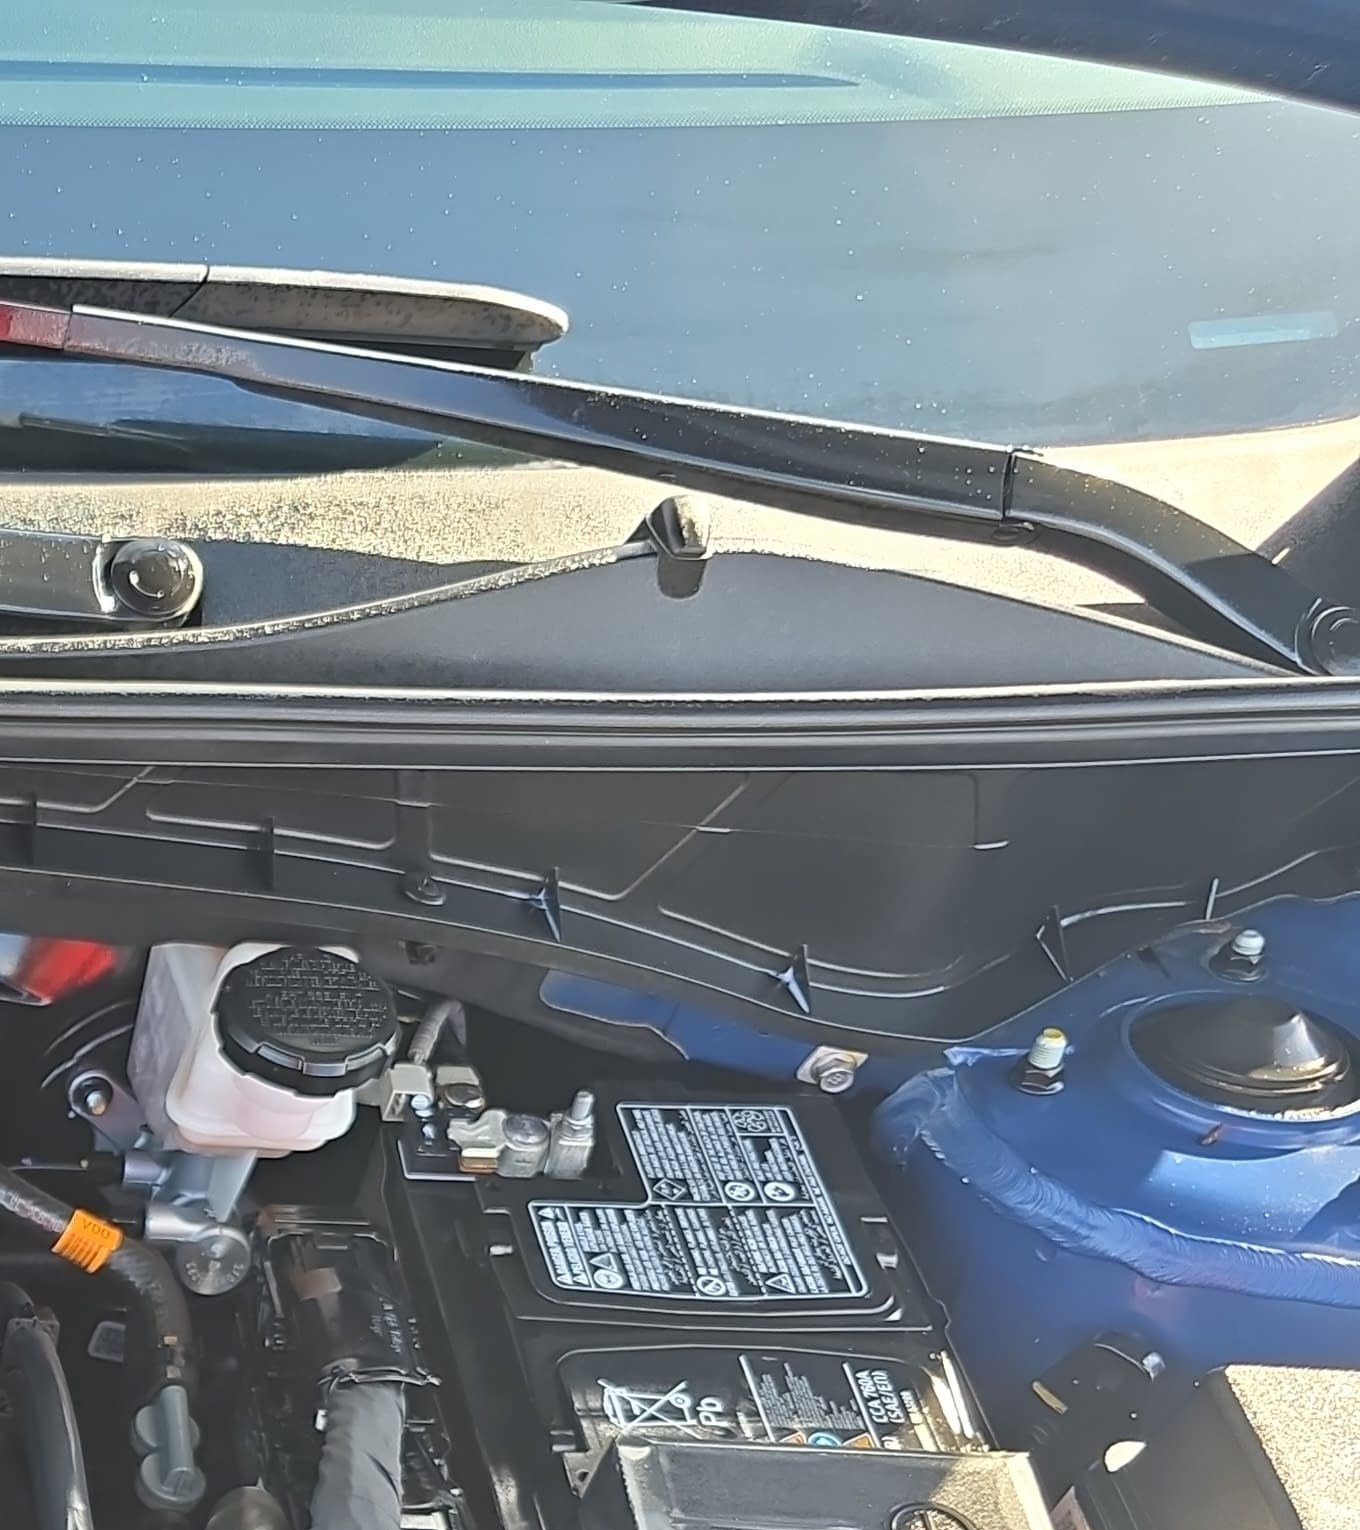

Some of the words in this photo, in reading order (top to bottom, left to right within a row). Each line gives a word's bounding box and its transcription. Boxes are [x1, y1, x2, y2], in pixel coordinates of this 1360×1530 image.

[855, 1369, 880, 1398] 760A
[696, 1396, 725, 1427] Pb
[869, 1400, 890, 1424] CCA
